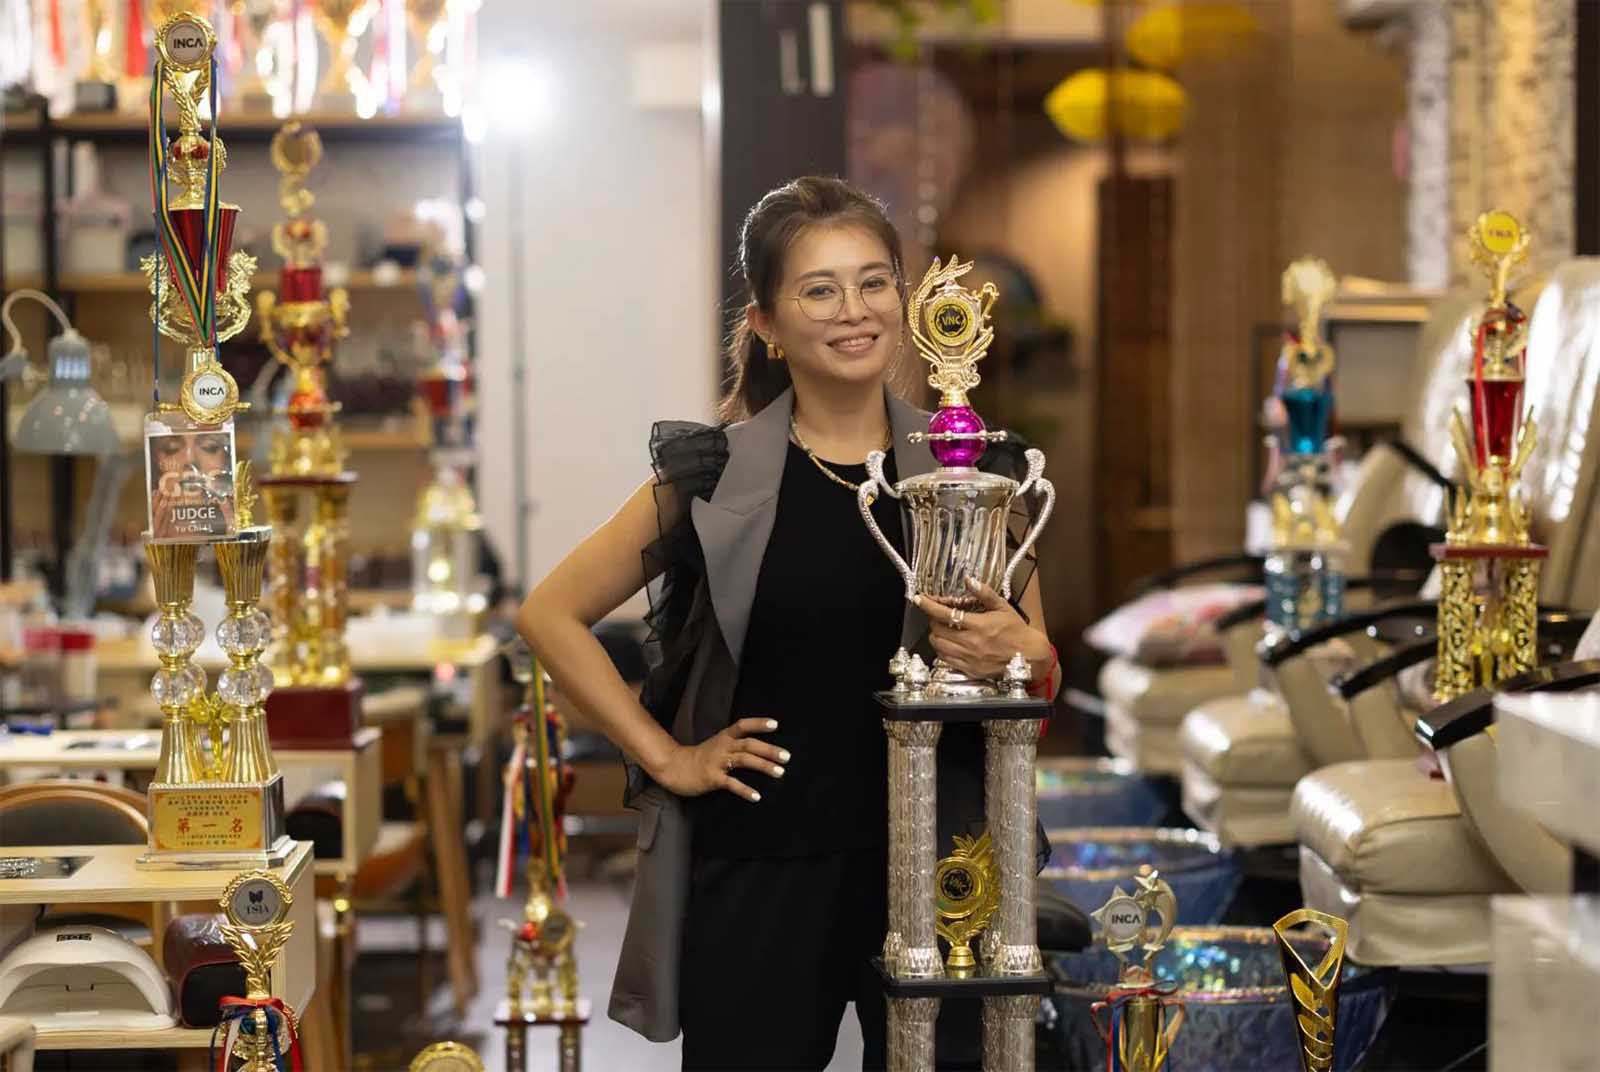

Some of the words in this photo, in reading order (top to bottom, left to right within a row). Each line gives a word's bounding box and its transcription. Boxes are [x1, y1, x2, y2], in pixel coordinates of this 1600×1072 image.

[173, 37, 204, 49] INCA
[199, 387, 225, 396] INCA
[170, 506, 217, 523] JUDGE
[1111, 914, 1140, 924] INCA
